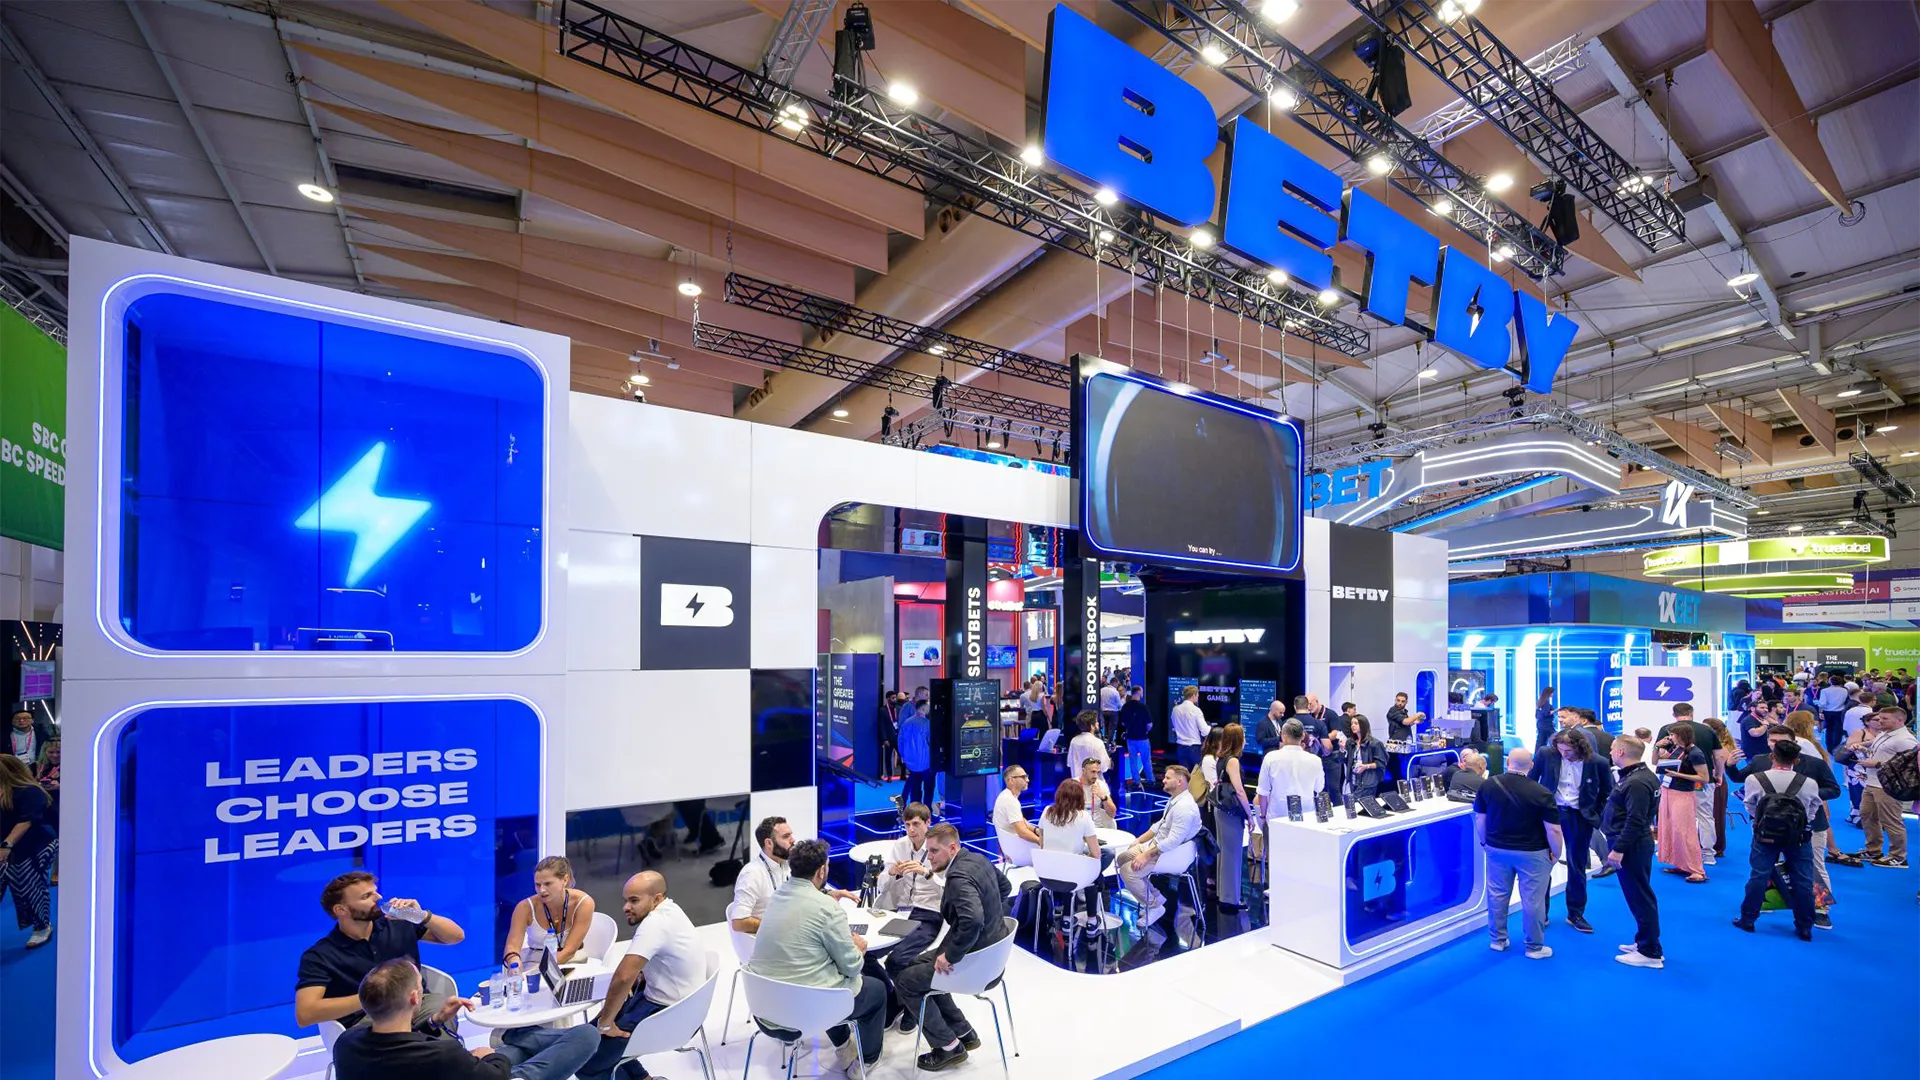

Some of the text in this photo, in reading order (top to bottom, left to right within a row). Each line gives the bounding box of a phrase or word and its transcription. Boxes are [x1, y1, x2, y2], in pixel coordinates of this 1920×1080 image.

[1042, 2, 1579, 394] BETBY
[32, 422, 59, 453] SBC
[26, 450, 66, 486] SPEED
[1304, 458, 1392, 511] BET
[1661, 479, 1695, 529] 1X
[1187, 544, 1199, 553] You
[1199, 546, 1209, 554] can
[1810, 542, 1871, 554] truelabel
[1332, 585, 1389, 602] BETBY
[1658, 591, 1701, 625] 1XBET
[967, 587, 981, 678] SLOTBETS
[1086, 595, 1097, 704] SPORTSBOOK
[205, 748, 478, 787] LEADERS
[215, 781, 469, 824] CHOOSE
[204, 814, 478, 864] LEADERS
